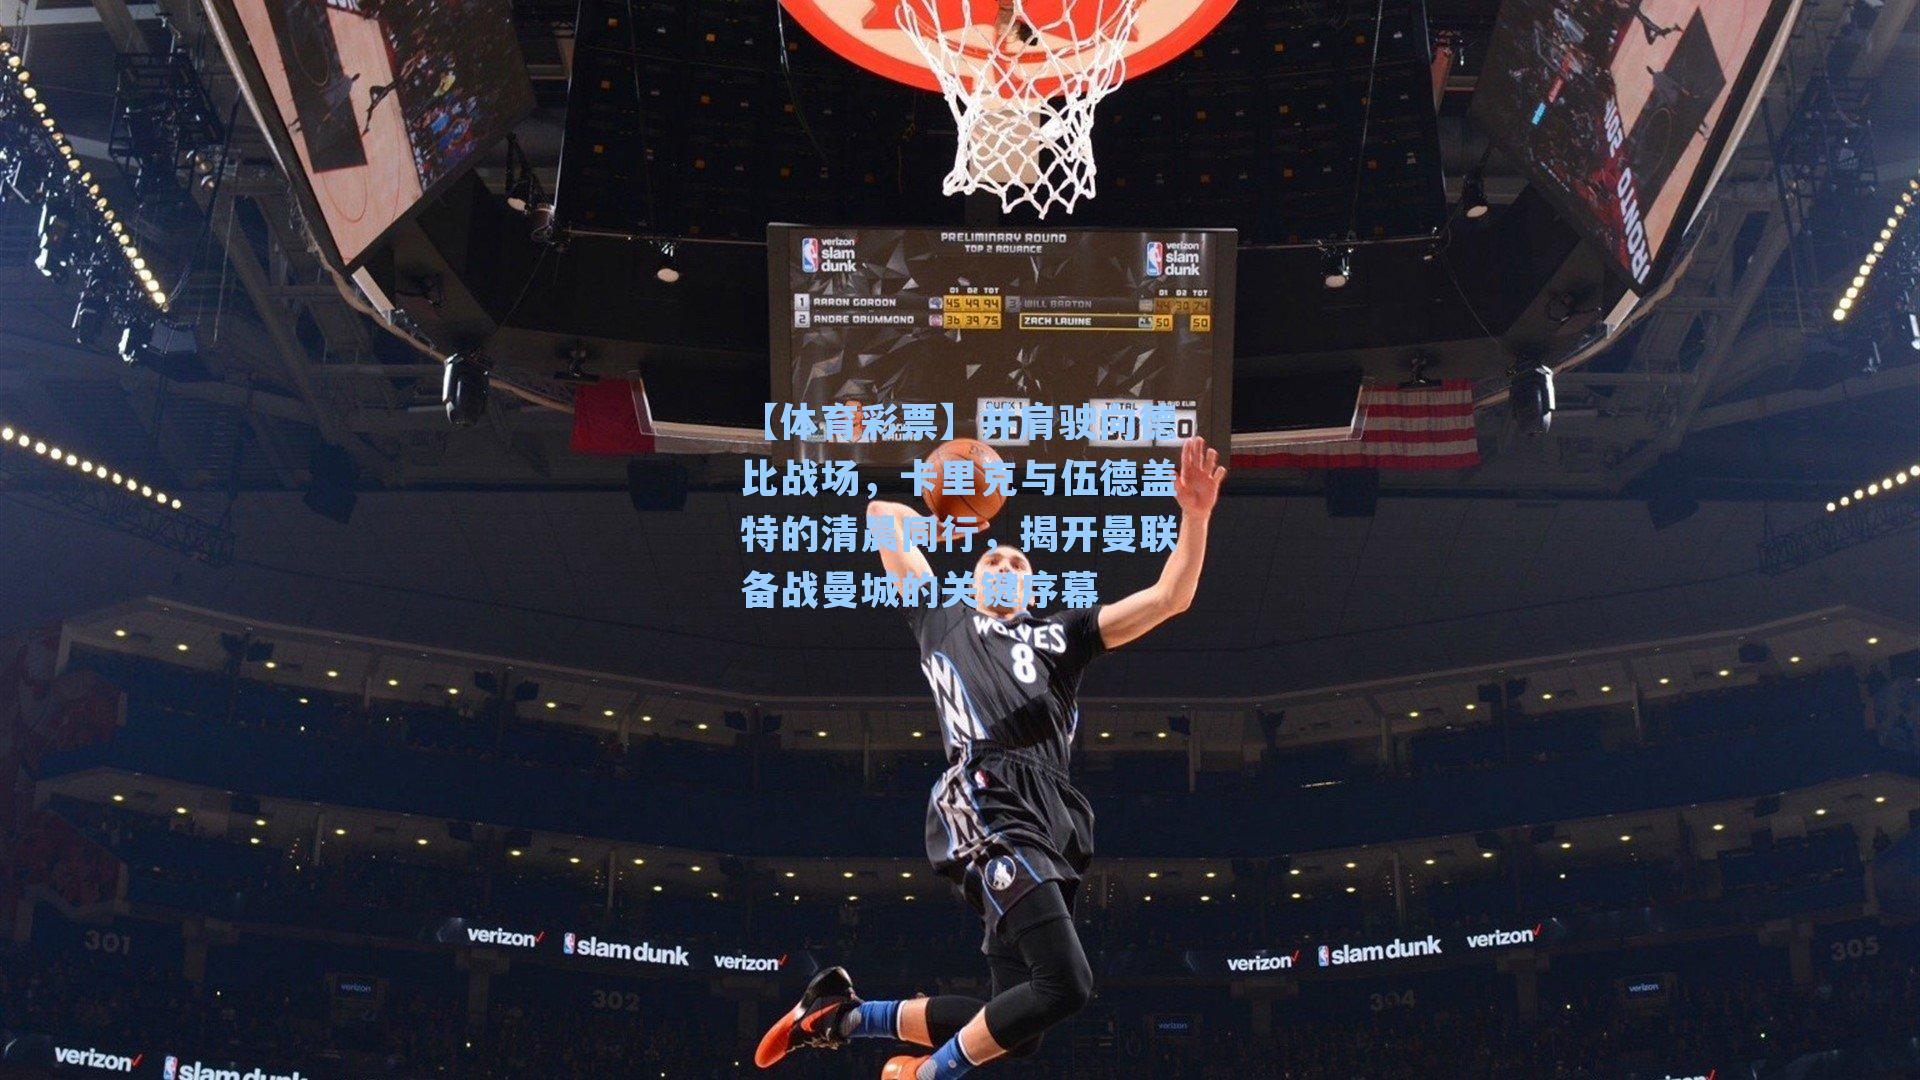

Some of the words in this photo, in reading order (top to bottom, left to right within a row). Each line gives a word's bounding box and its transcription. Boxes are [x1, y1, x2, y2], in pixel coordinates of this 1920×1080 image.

[821, 237, 855, 246] verizon
[941, 232, 1021, 242] PRELIMINARY
[1025, 233, 1067, 243] ROUND
[965, 244, 984, 253] TOP
[987, 244, 993, 253] 2
[996, 245, 1042, 253] ADVANCE
[1166, 241, 1199, 250] verizon
[821, 246, 855, 259] slam
[1165, 250, 1199, 263] slam
[821, 259, 857, 272] dunk
[1165, 263, 1200, 276] dunk
[813, 298, 850, 307] AARON
[852, 298, 897, 307] GORDON
[946, 299, 960, 308] 45
[965, 299, 979, 308] 49
[984, 299, 999, 308] 94
[1050, 299, 1092, 308] BARTON
[1193, 301, 1208, 311] 74
[813, 315, 849, 324] ANDRE
[852, 315, 914, 324] DRUMMOND
[965, 316, 979, 325] 39
[984, 316, 998, 325] 75
[1024, 317, 1051, 326] ZACH
[1054, 317, 1092, 326] LAVINE
[1156, 318, 1170, 327] 50
[1193, 318, 1208, 327] 50
[1104, 402, 1138, 410] TTAL
[1011, 643, 1037, 684] 8
[84, 930, 131, 954] 301
[467, 927, 535, 948] verizon
[1466, 929, 1534, 948] verizon
[1831, 936, 1880, 961] 305
[714, 954, 779, 971] verizon
[1227, 954, 1292, 971] verizon
[341, 982, 371, 993] verizon
[1628, 983, 1660, 993] verizon
[594, 989, 640, 1011] 302
[55, 1046, 131, 1072] verizon
